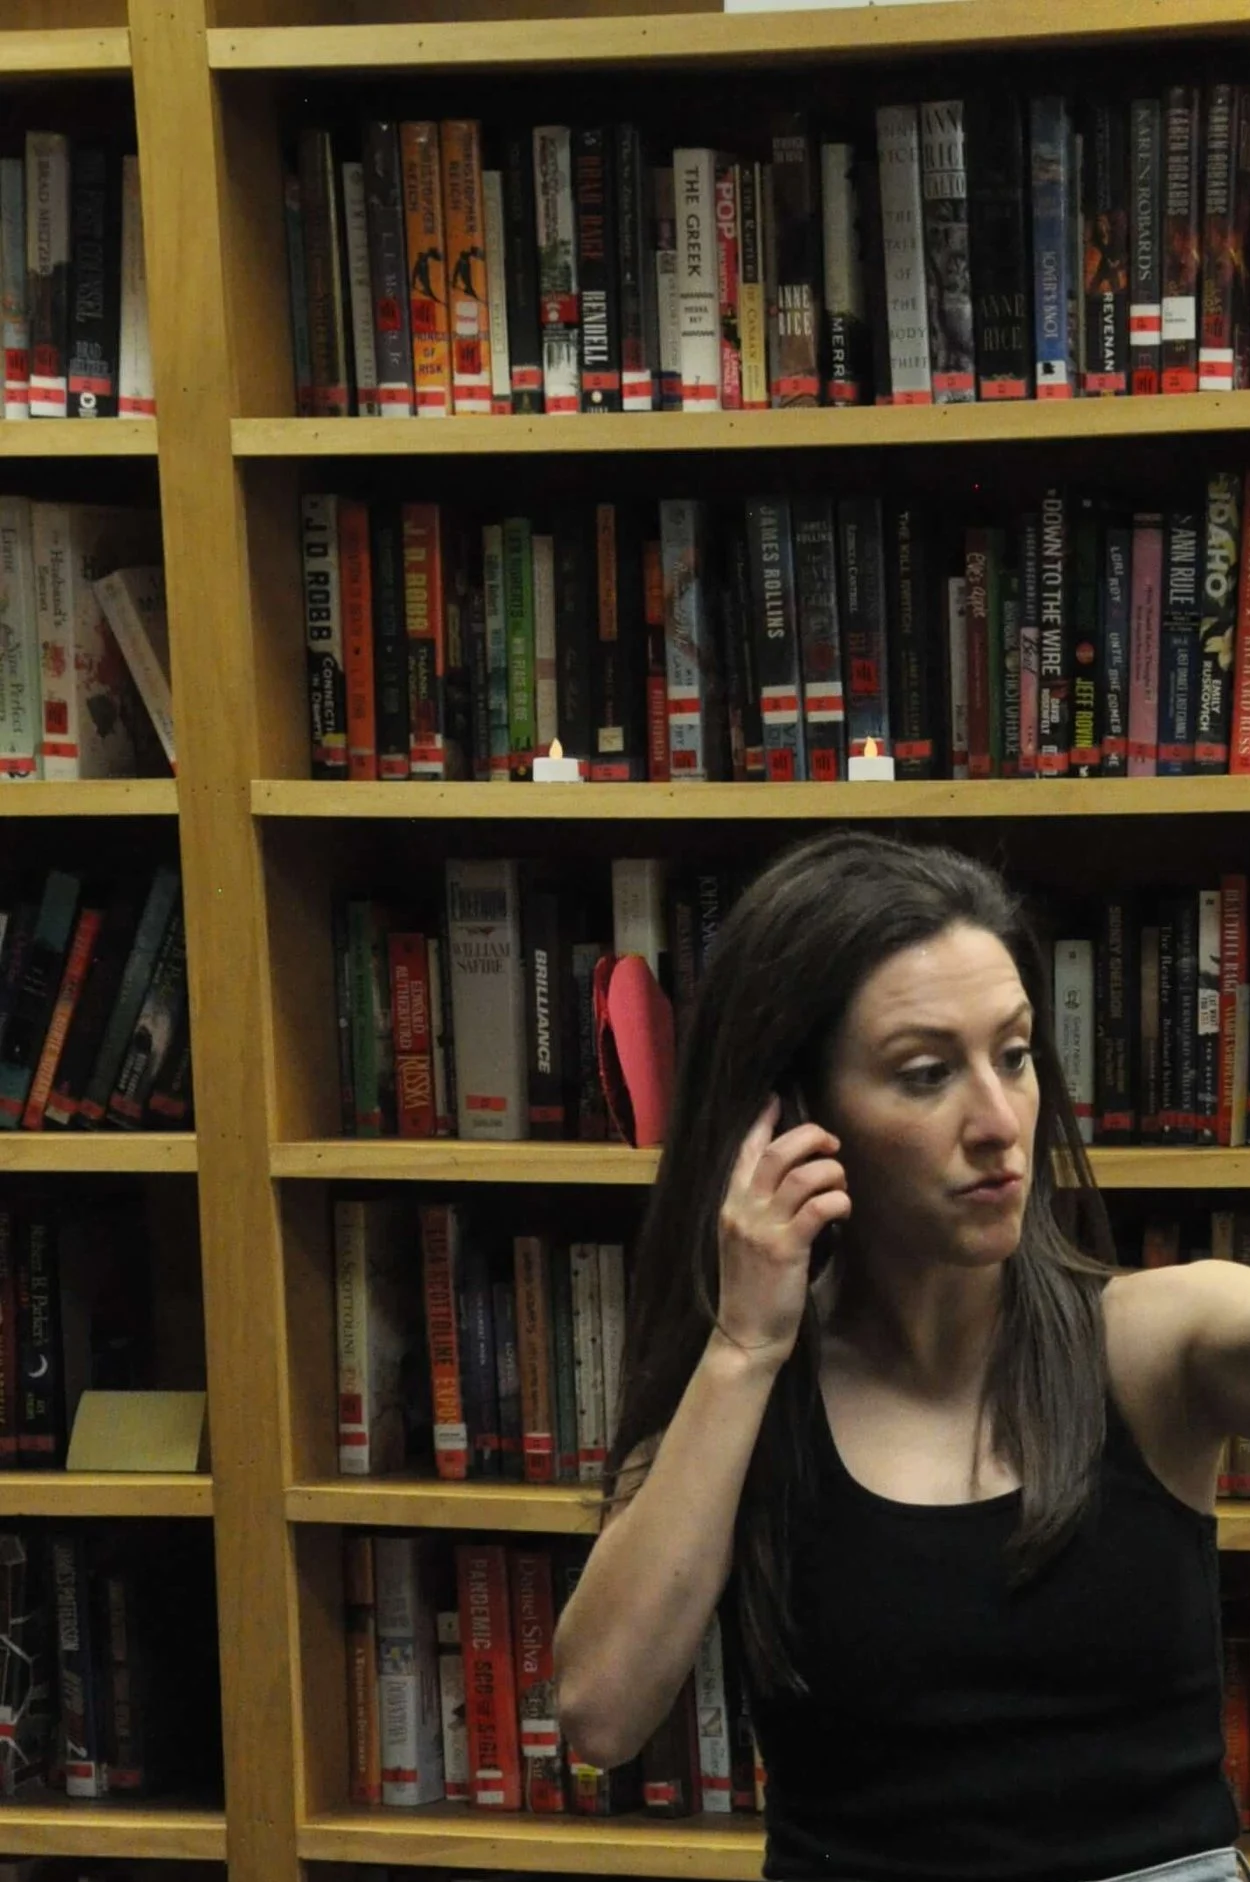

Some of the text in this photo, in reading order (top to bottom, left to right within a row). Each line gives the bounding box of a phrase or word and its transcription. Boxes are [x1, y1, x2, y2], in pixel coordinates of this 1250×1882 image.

[685, 167, 701, 277] THE GREEK
[717, 182, 734, 239] POP
[1137, 187, 1153, 281] ROBARDS
[583, 291, 608, 365] RENDELL
[759, 505, 784, 640] JAMES ROLLINS
[1169, 527, 1195, 605] ANN RULE
[1205, 493, 1235, 599] IDAHO
[1040, 498, 1062, 676] DOWN TO THE WIRE
[10, 683, 24, 734] Perfect
[1004, 672, 1019, 703] FIRST
[1049, 697, 1062, 723] DAVID
[1074, 678, 1095, 748] JEFF ROVIN
[1199, 660, 1223, 733] EMILY RUSKOVICH
[1160, 925, 1173, 1004] The Reader
[410, 980, 425, 1034] EDWARD
[534, 948, 550, 1074] BRILLIANCE
[398, 1054, 430, 1109] RUSSKA
[341, 1261, 359, 1359] SCOTTOLINE
[427, 1269, 451, 1367] SCOTTOLINE
[469, 1557, 491, 1651] PANDEMIC
[517, 1557, 542, 1674] Daniel Silva
